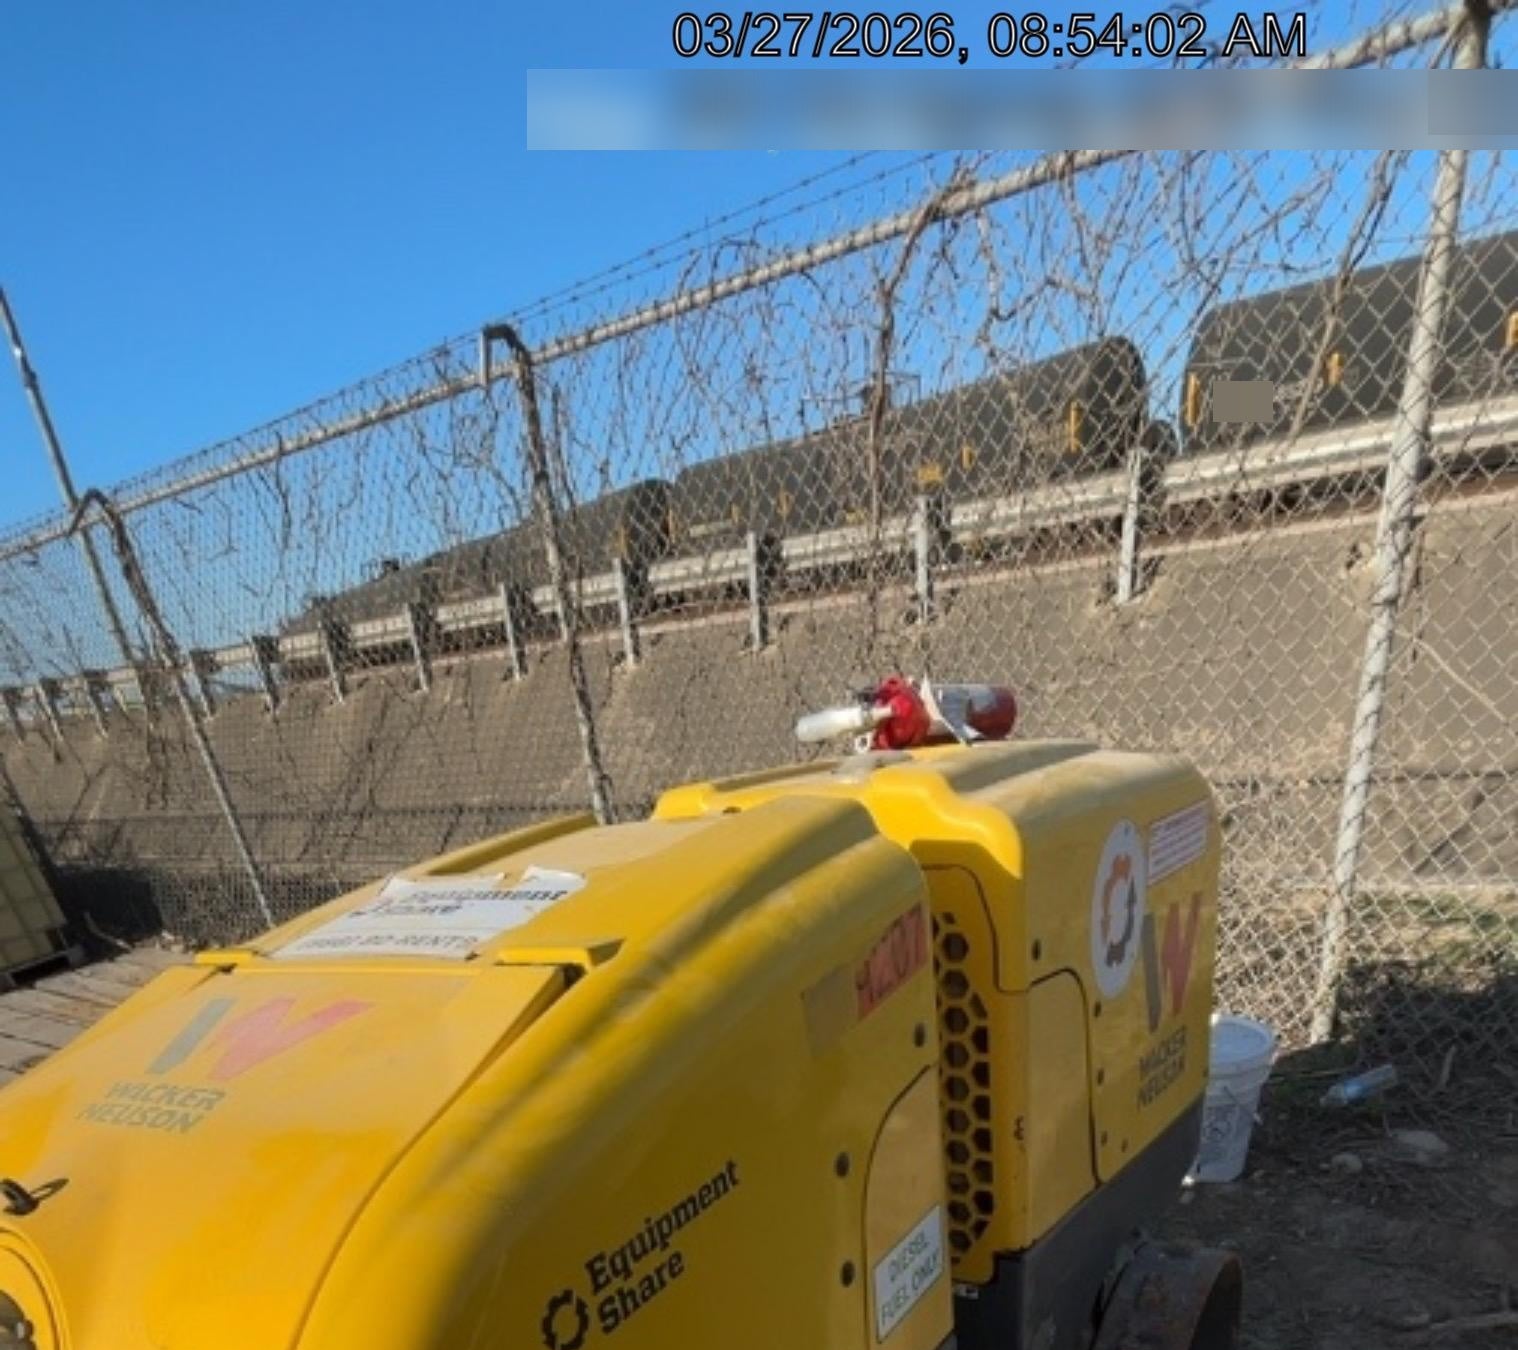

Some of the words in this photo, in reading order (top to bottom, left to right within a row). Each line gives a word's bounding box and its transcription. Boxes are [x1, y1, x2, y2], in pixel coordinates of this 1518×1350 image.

[1139, 1026, 1188, 1074] WACKER
[105, 1082, 226, 1111] WACKER
[1138, 1060, 1186, 1108] NEUSON
[76, 1104, 206, 1133] NEUSON
[584, 1158, 740, 1297] Equipment
[597, 1250, 685, 1334] Share
